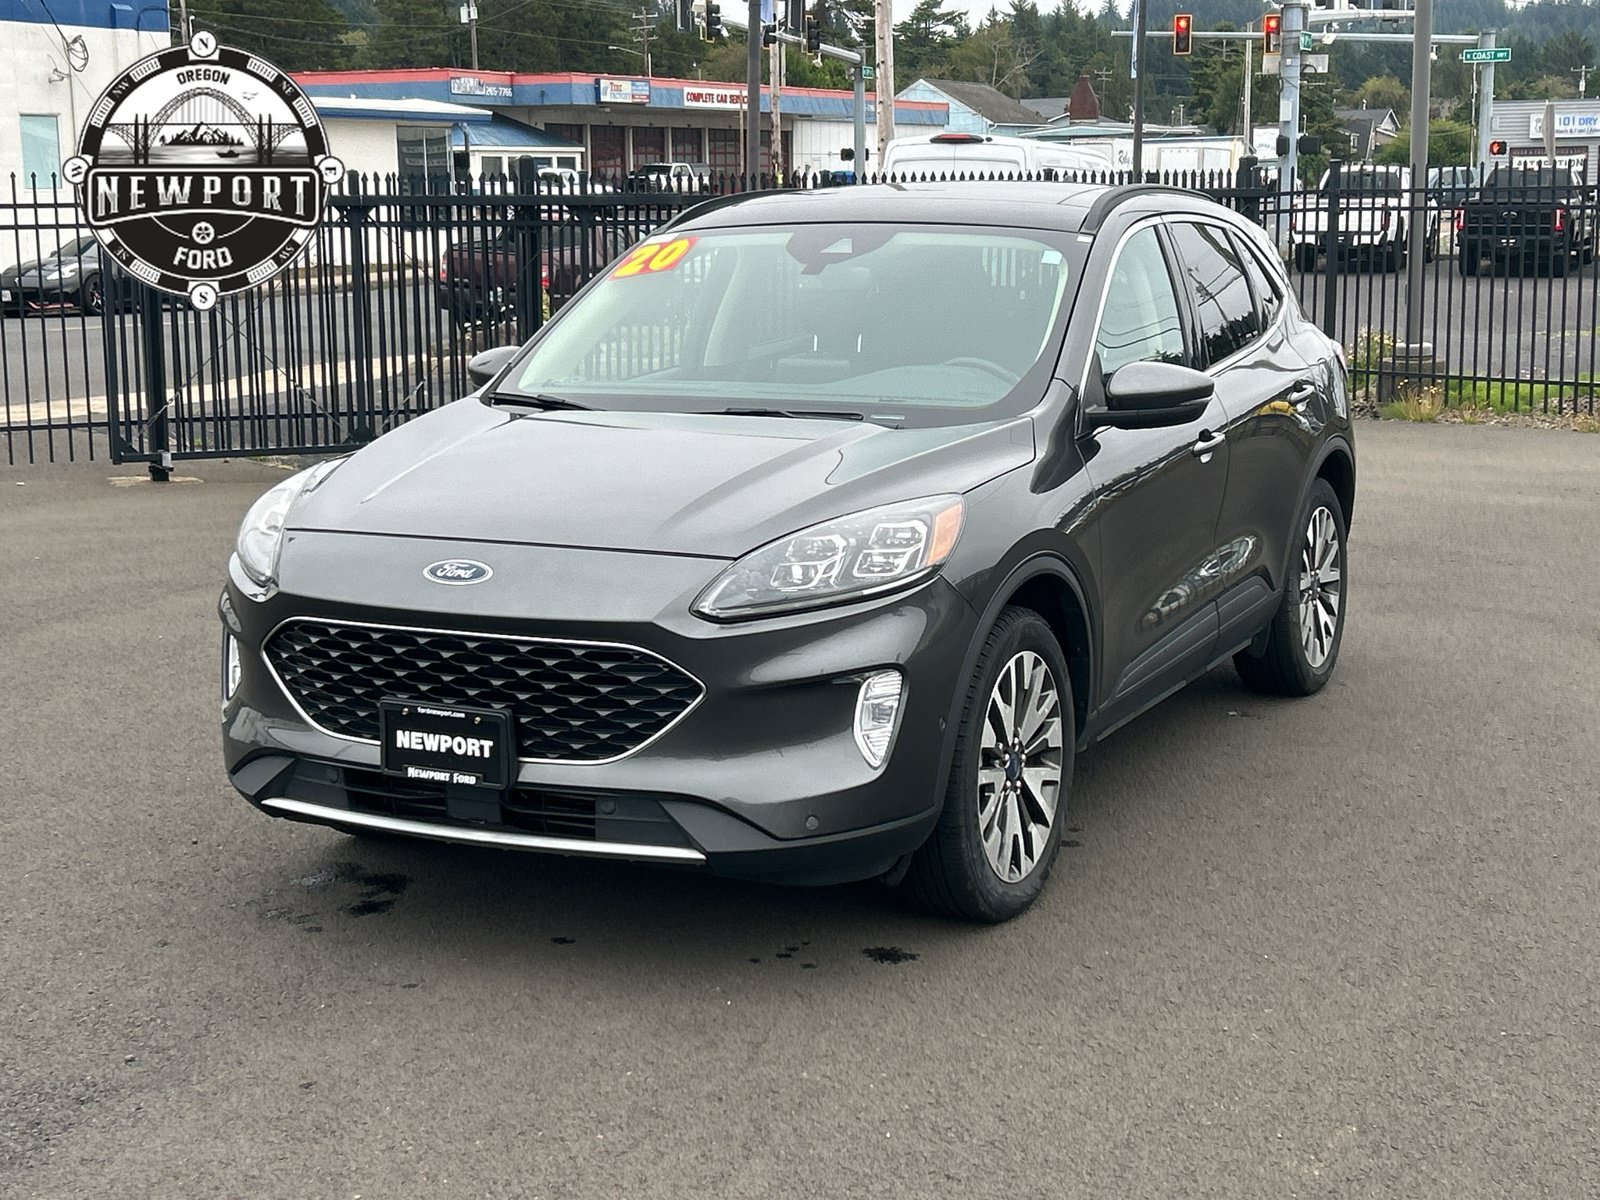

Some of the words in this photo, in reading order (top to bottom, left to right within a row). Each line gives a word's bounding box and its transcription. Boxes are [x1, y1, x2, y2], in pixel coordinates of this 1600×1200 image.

[1472, 51, 1495, 60] COAST
[686, 91, 715, 103] COMPLETE
[716, 93, 728, 104] CAR
[1558, 116, 1576, 127] 101
[1578, 116, 1599, 127] DRY
[613, 238, 690, 278] 20
[436, 563, 477, 578] Ford
[396, 729, 494, 758] NEWPORT
[407, 766, 451, 782] NEWPORT
[452, 772, 477, 785] FORD
